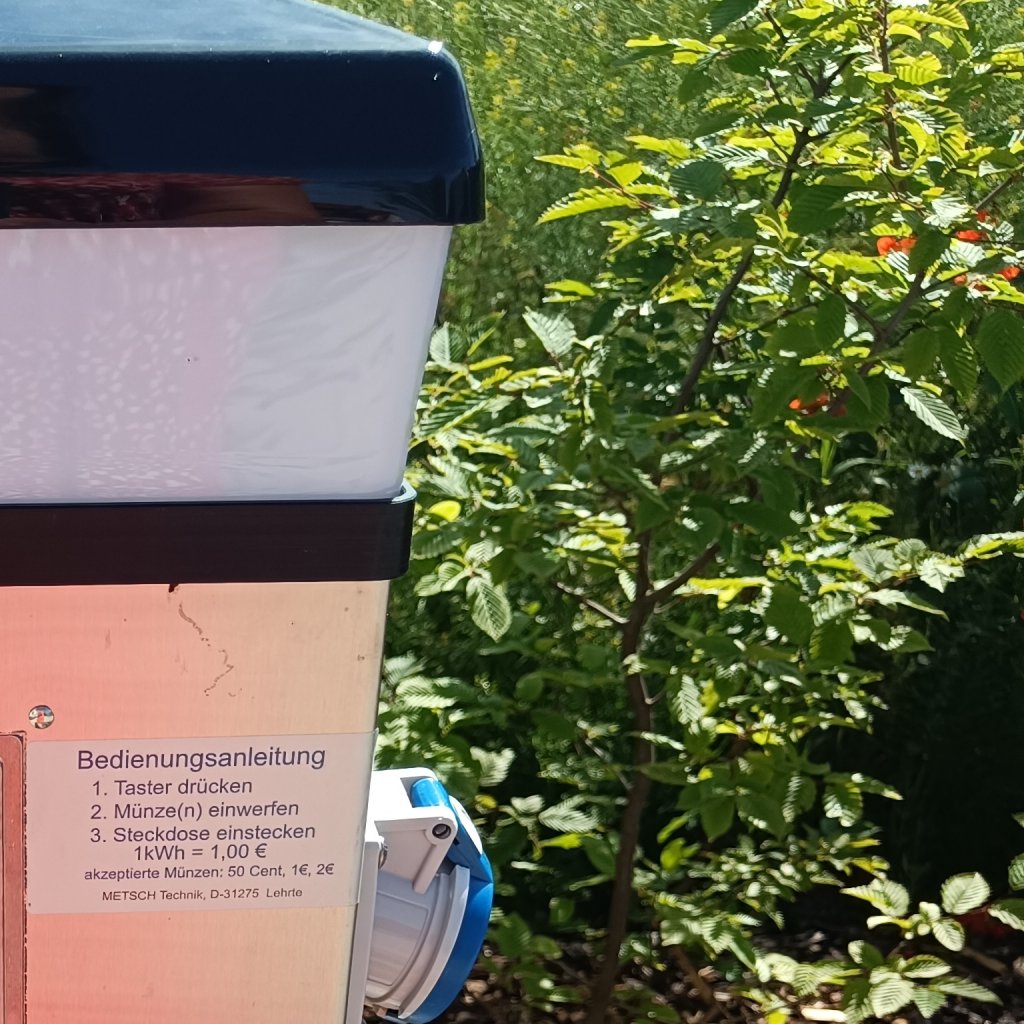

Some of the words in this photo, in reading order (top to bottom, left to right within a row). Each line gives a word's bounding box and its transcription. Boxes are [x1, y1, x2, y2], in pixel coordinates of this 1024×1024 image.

[78, 747, 325, 772] Bedienungsanleitung
[92, 781, 108, 796] 1.
[115, 780, 172, 796] Taster
[178, 778, 252, 795] drücken
[91, 805, 107, 819] 2.
[114, 803, 202, 821] Münze(n)
[209, 801, 299, 818] einwerfen
[91, 828, 106, 843] 3.
[114, 826, 210, 842] Steckdose
[217, 825, 315, 840] einstecken
[134, 845, 185, 861] 1kWh
[211, 844, 249, 862] 1,00
[255, 843, 267, 859] €
[85, 867, 159, 881] akzeptierte
[164, 866, 223, 879] Münzen:
[228, 865, 244, 877] 50
[250, 864, 285, 878] Cent,
[292, 864, 310, 877] 1€,
[317, 863, 334, 875] 2€
[102, 890, 156, 901] METSCH
[160, 889, 206, 901] Technik,
[210, 889, 259, 899] D-31275
[267, 888, 302, 898] Lehrte
